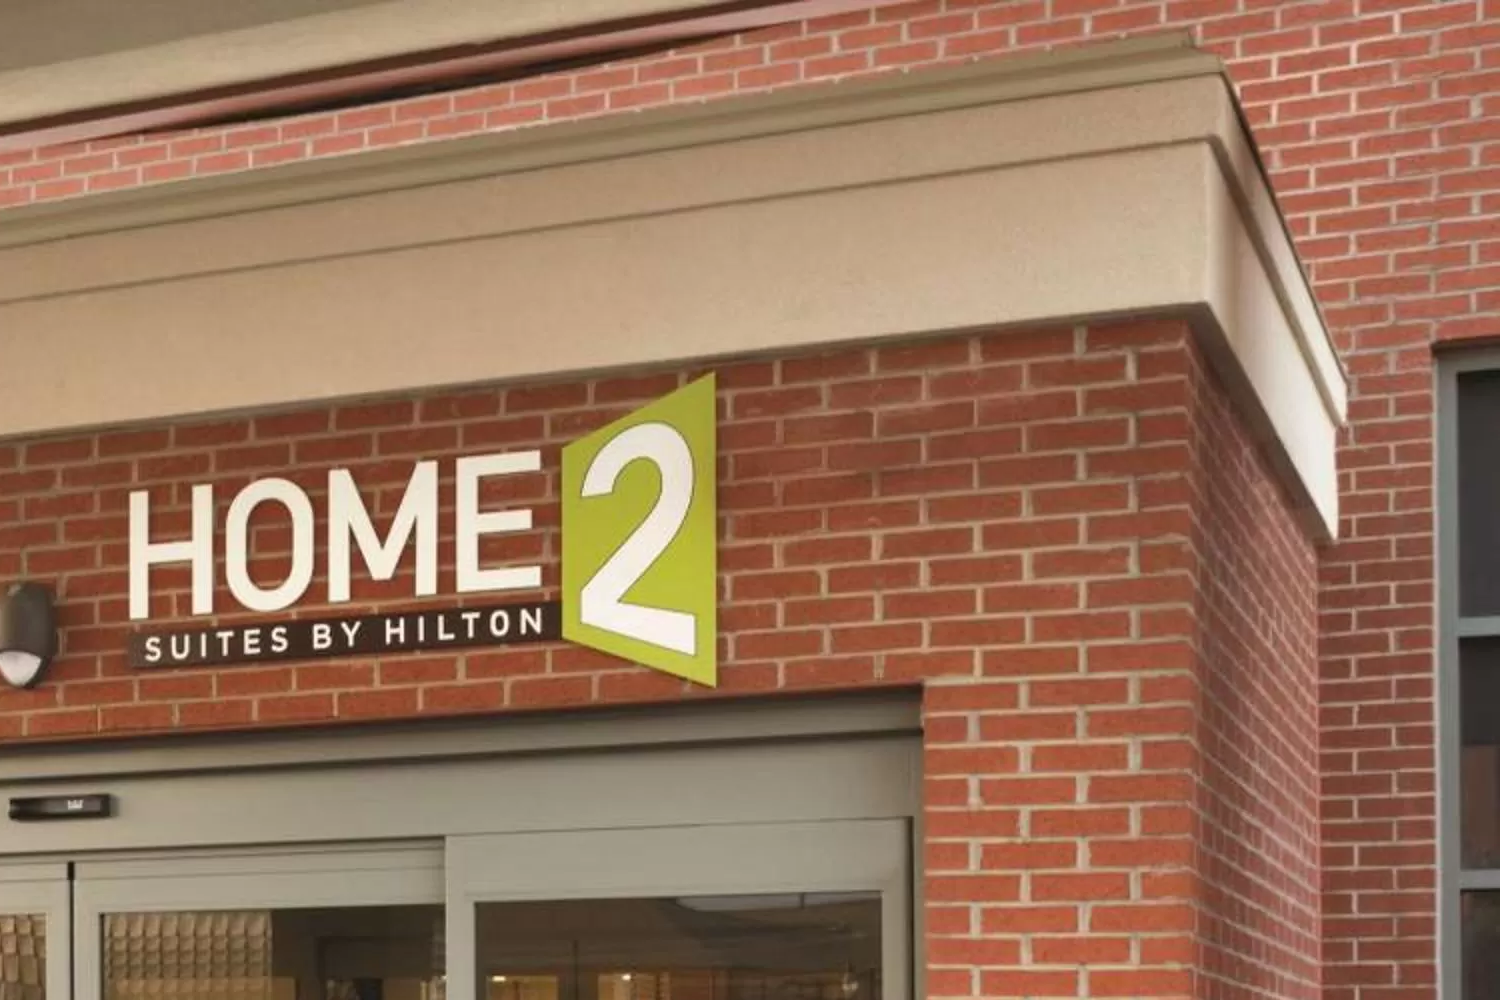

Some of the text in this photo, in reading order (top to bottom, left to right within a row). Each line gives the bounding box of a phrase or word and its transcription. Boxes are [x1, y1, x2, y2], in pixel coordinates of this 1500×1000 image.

[128, 421, 697, 656] HOME 2
[145, 607, 543, 662] SUITES BY HILTON
